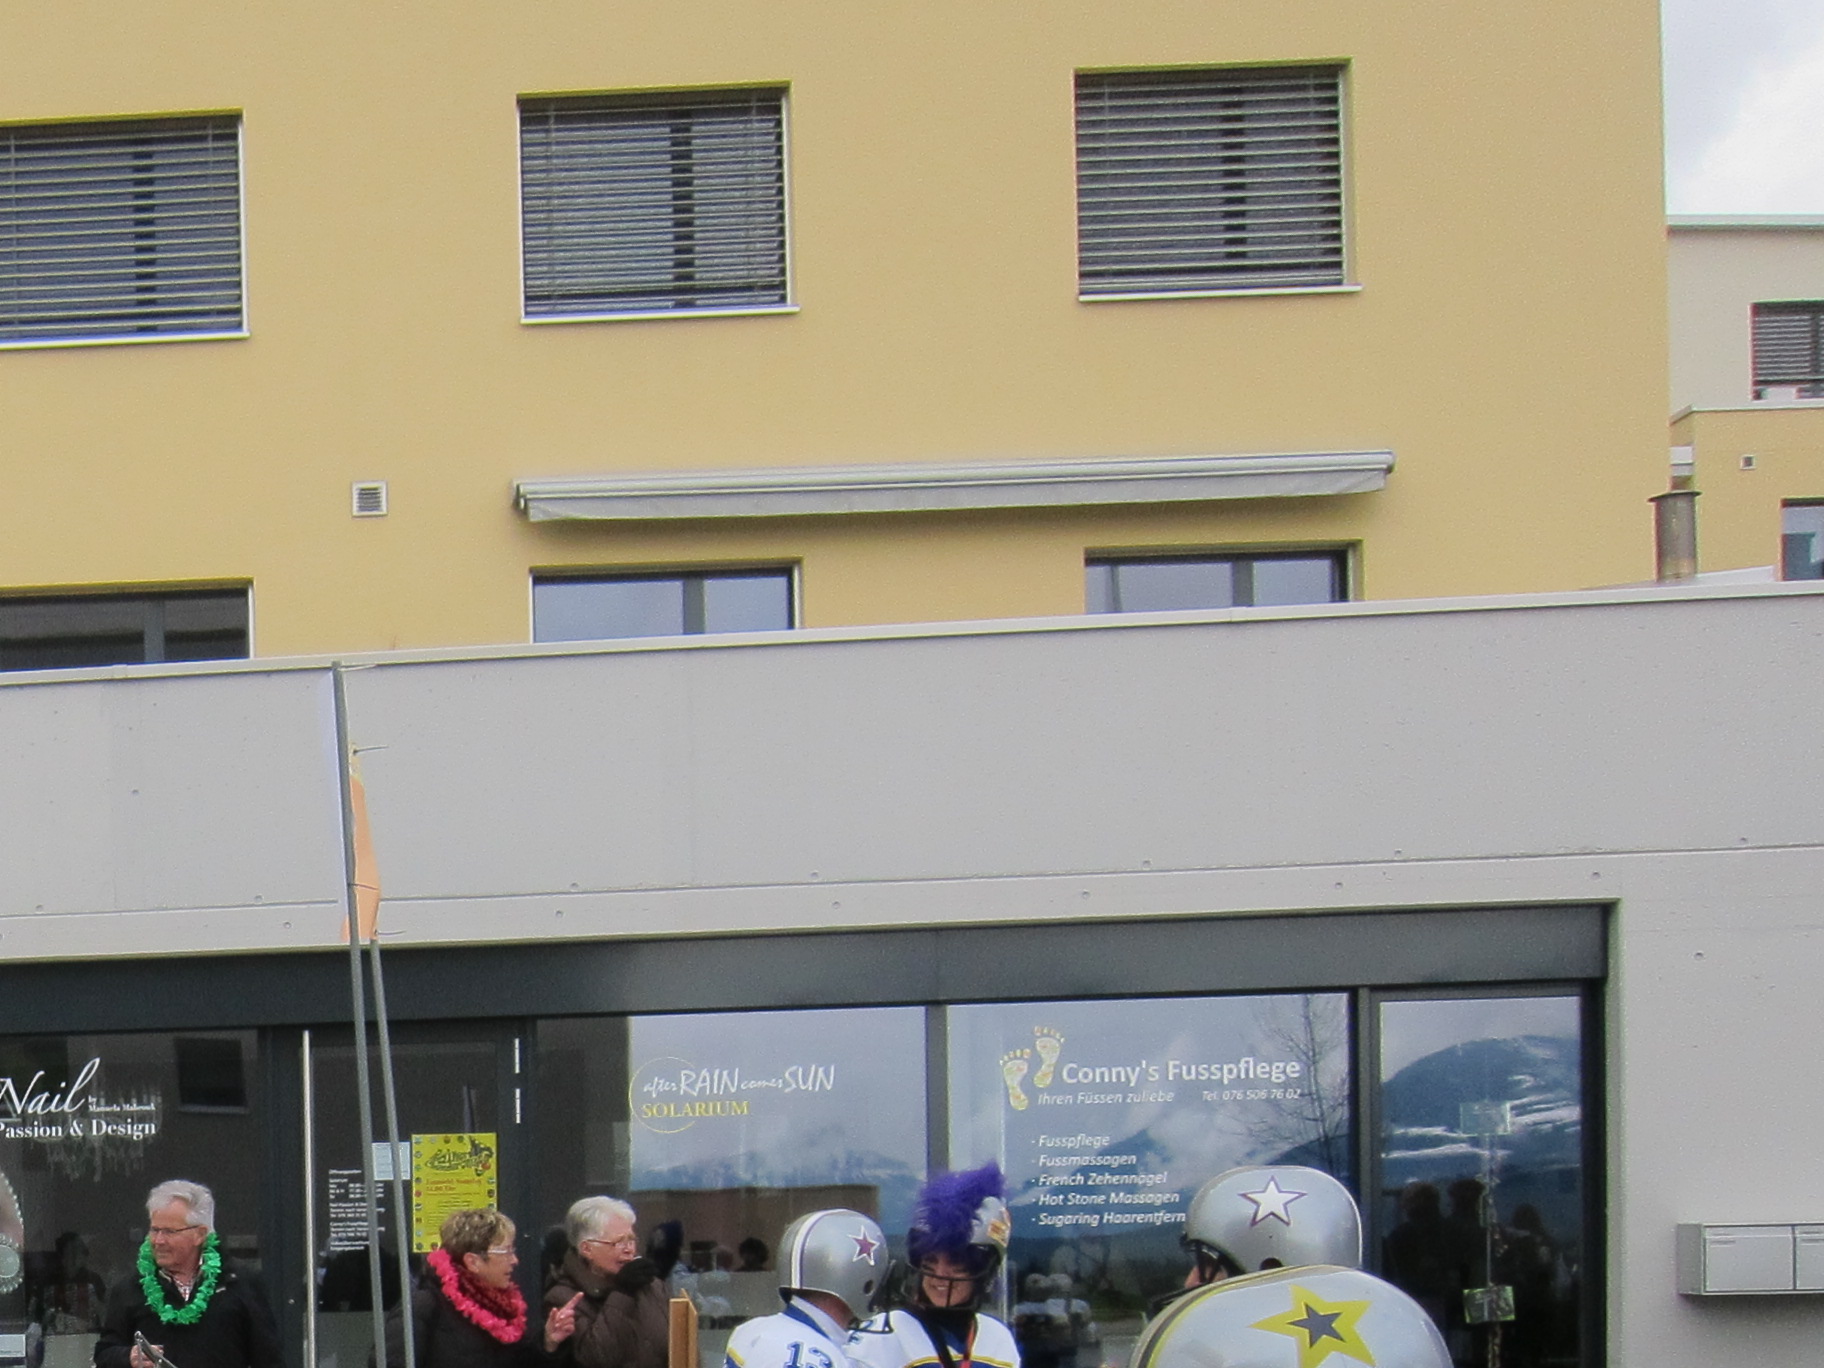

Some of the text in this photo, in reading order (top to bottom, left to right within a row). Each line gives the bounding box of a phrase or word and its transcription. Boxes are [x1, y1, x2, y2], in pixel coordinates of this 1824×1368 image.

[1062, 1057, 1301, 1087] Conny's Fusspflege
[643, 1076, 678, 1098] after
[679, 1067, 740, 1097] RAIN
[783, 1064, 835, 1093] SUN
[1037, 1090, 1175, 1105] Ihren Füssen zuliebe
[641, 1101, 750, 1119] SOLARIUM
[69, 1119, 84, 1137] &
[91, 1118, 157, 1141] Design
[1038, 1133, 1110, 1149] Fusspflege
[1038, 1154, 1137, 1168] Fussmassagen
[1038, 1174, 1084, 1186] French
[1038, 1192, 1180, 1206] Hot Stone Massagen
[1038, 1210, 1187, 1227] Sugaring Haarentfern
